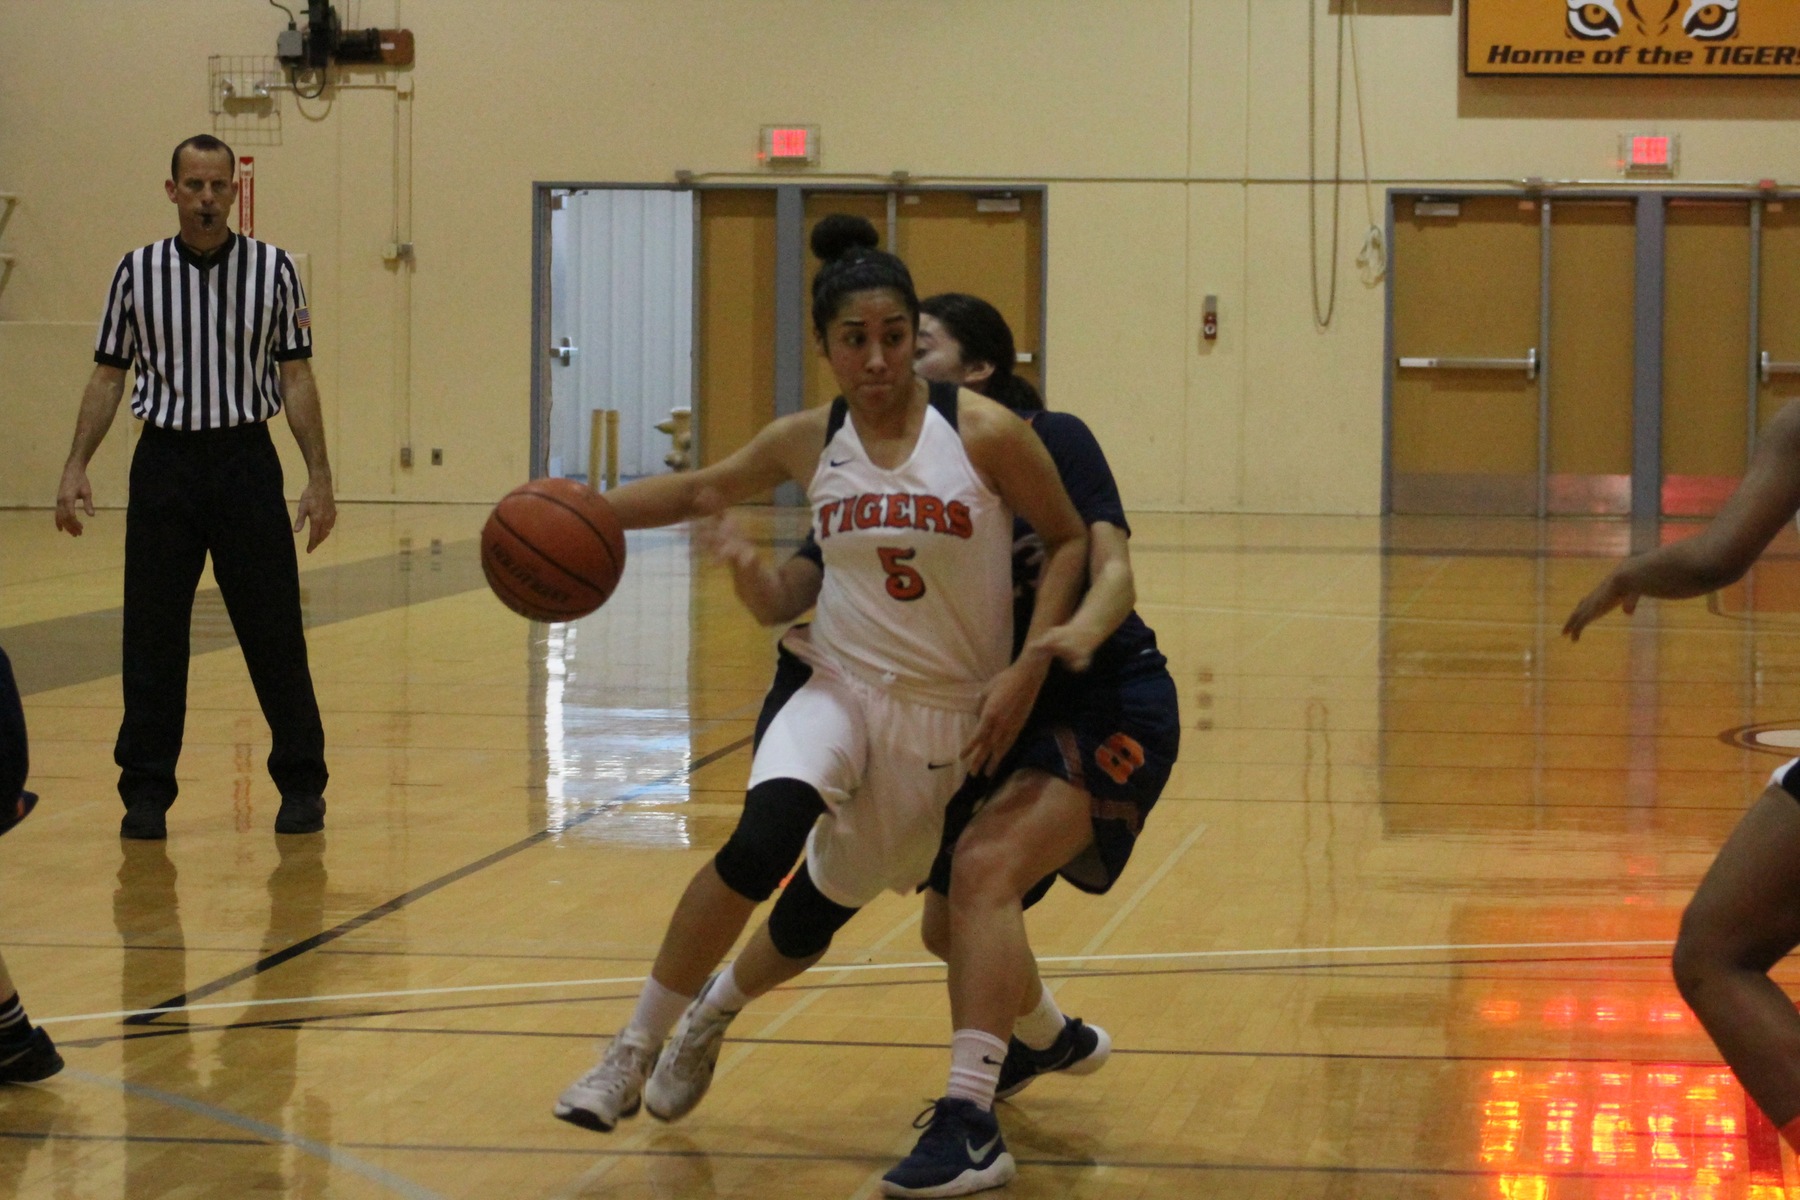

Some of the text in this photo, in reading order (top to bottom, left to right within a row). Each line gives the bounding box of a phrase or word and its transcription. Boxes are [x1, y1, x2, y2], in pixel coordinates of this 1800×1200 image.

[1487, 45, 1800, 66] Home of the TIGER
[819, 493, 973, 540] TIGERS
[877, 546, 926, 601] 5
